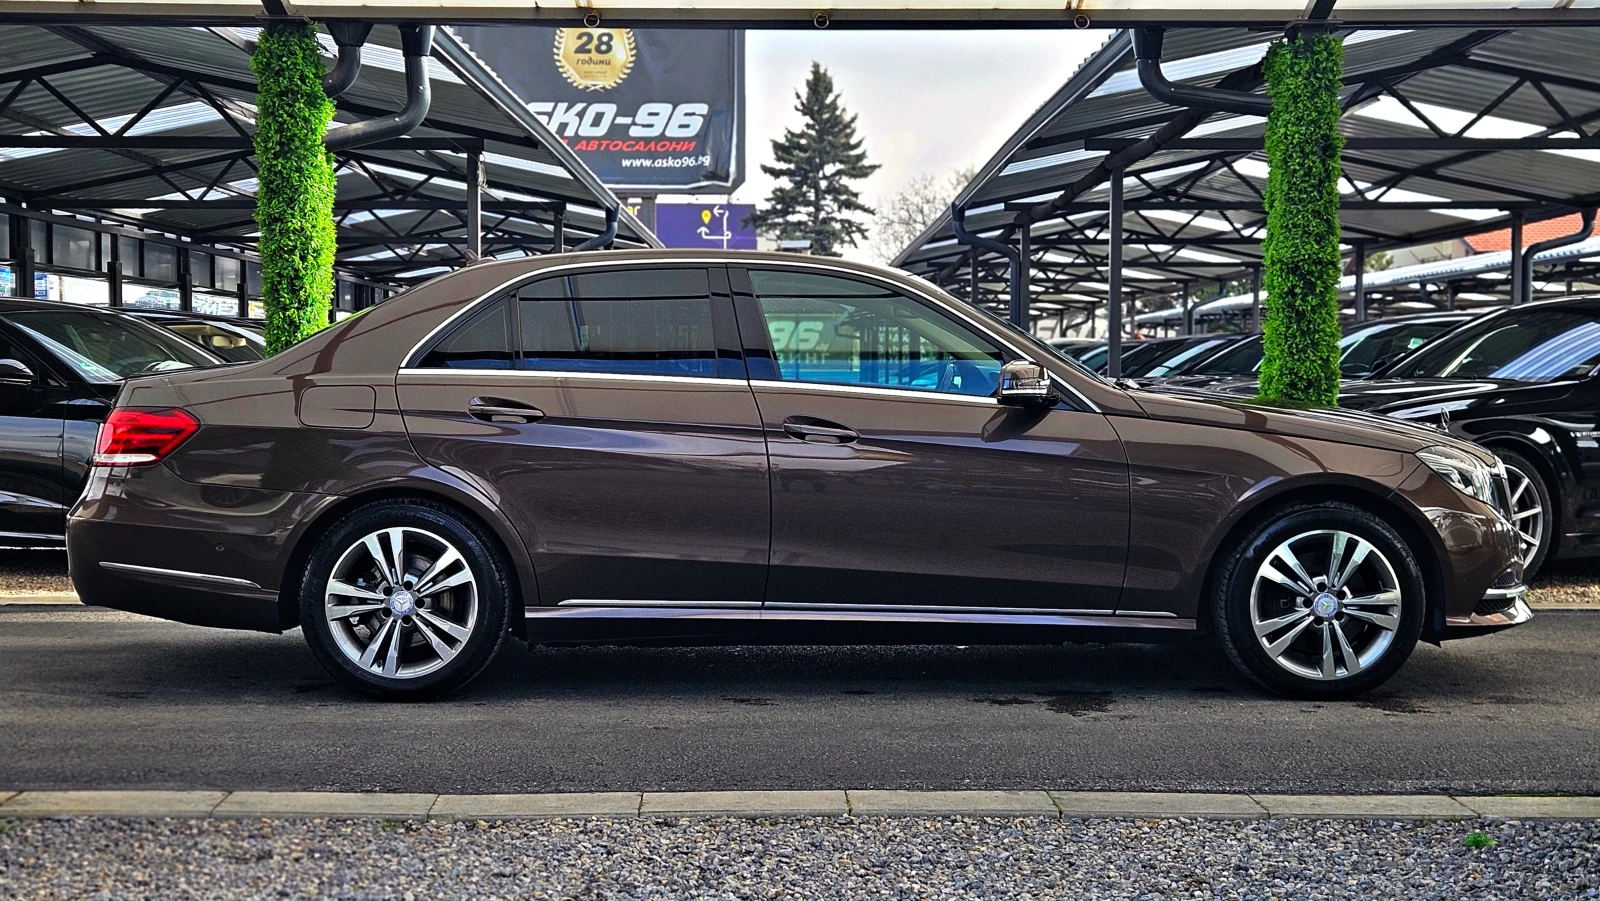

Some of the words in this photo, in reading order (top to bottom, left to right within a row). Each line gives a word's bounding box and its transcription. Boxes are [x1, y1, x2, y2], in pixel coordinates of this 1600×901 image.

[574, 31, 614, 54] 28
[576, 57, 611, 66] години
[573, 140, 697, 151] АВТОСАЛОНИ
[621, 155, 710, 167] www.asko96.bg
[767, 321, 824, 350] 96
